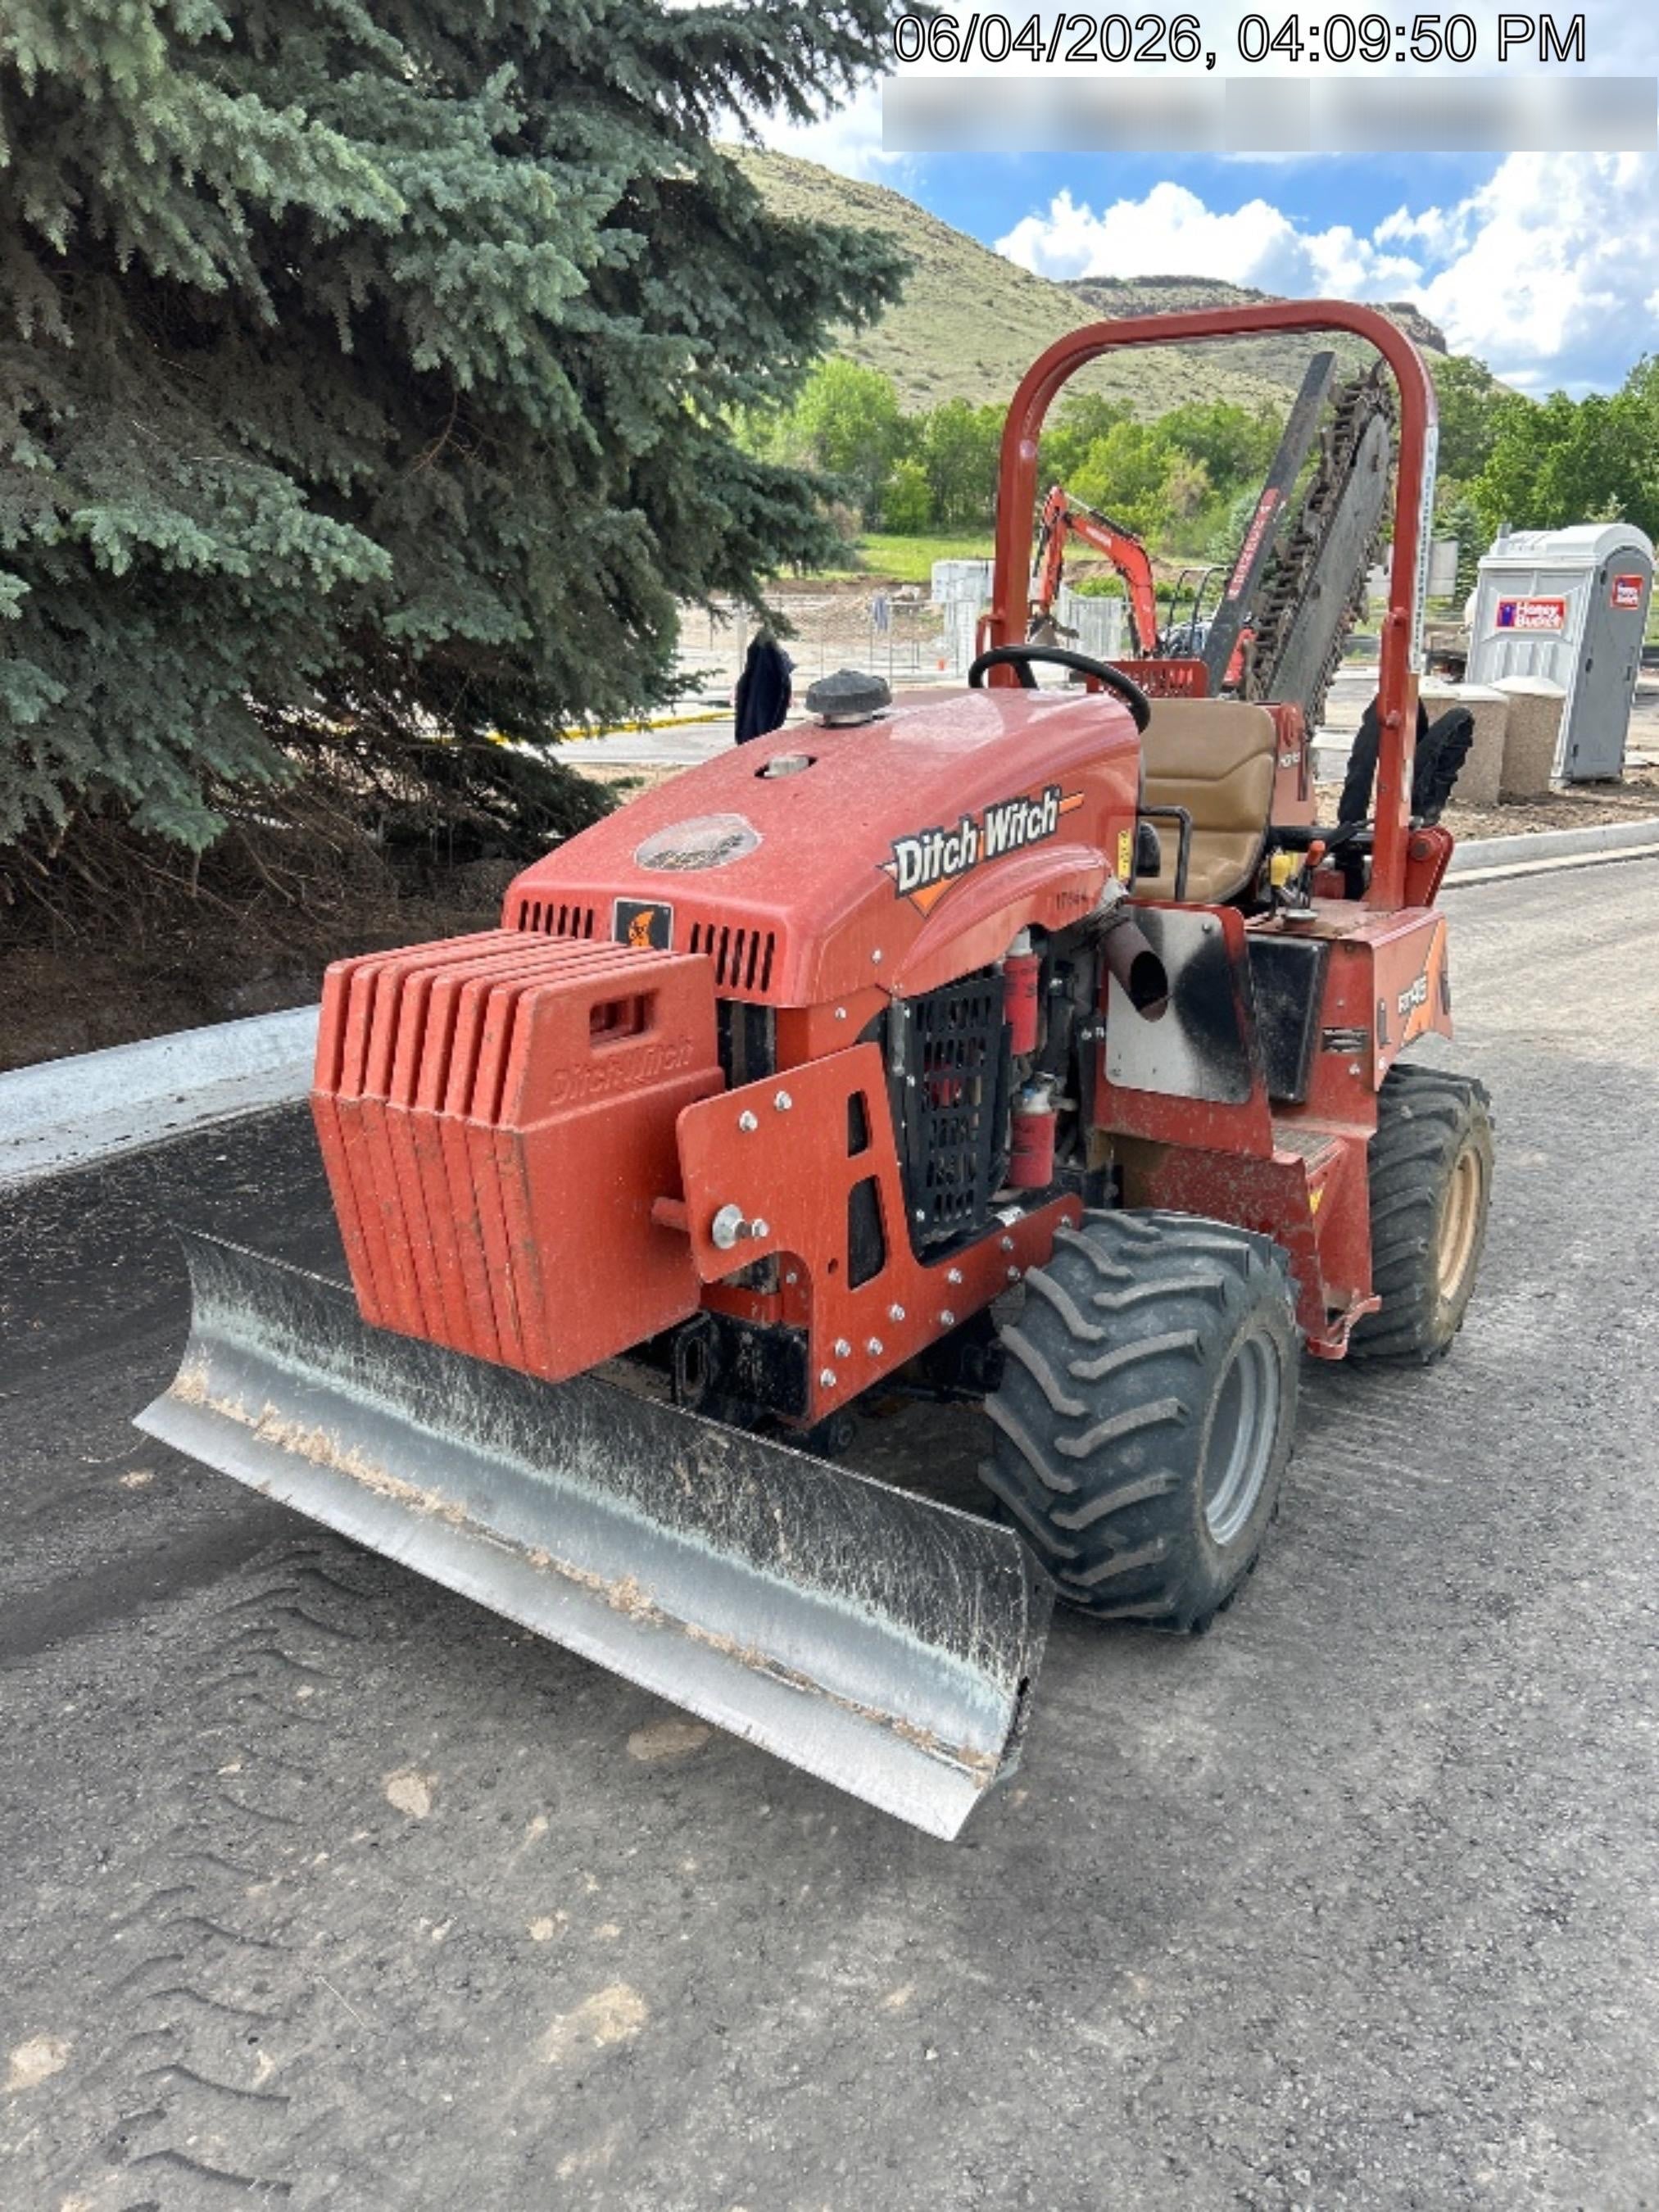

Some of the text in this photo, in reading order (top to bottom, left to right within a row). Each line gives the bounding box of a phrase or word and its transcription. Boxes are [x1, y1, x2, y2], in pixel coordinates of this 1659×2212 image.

[894, 818, 977, 893] Ditch
[985, 787, 1060, 857] Witch
[550, 1035, 694, 1106] Ditch Witch
